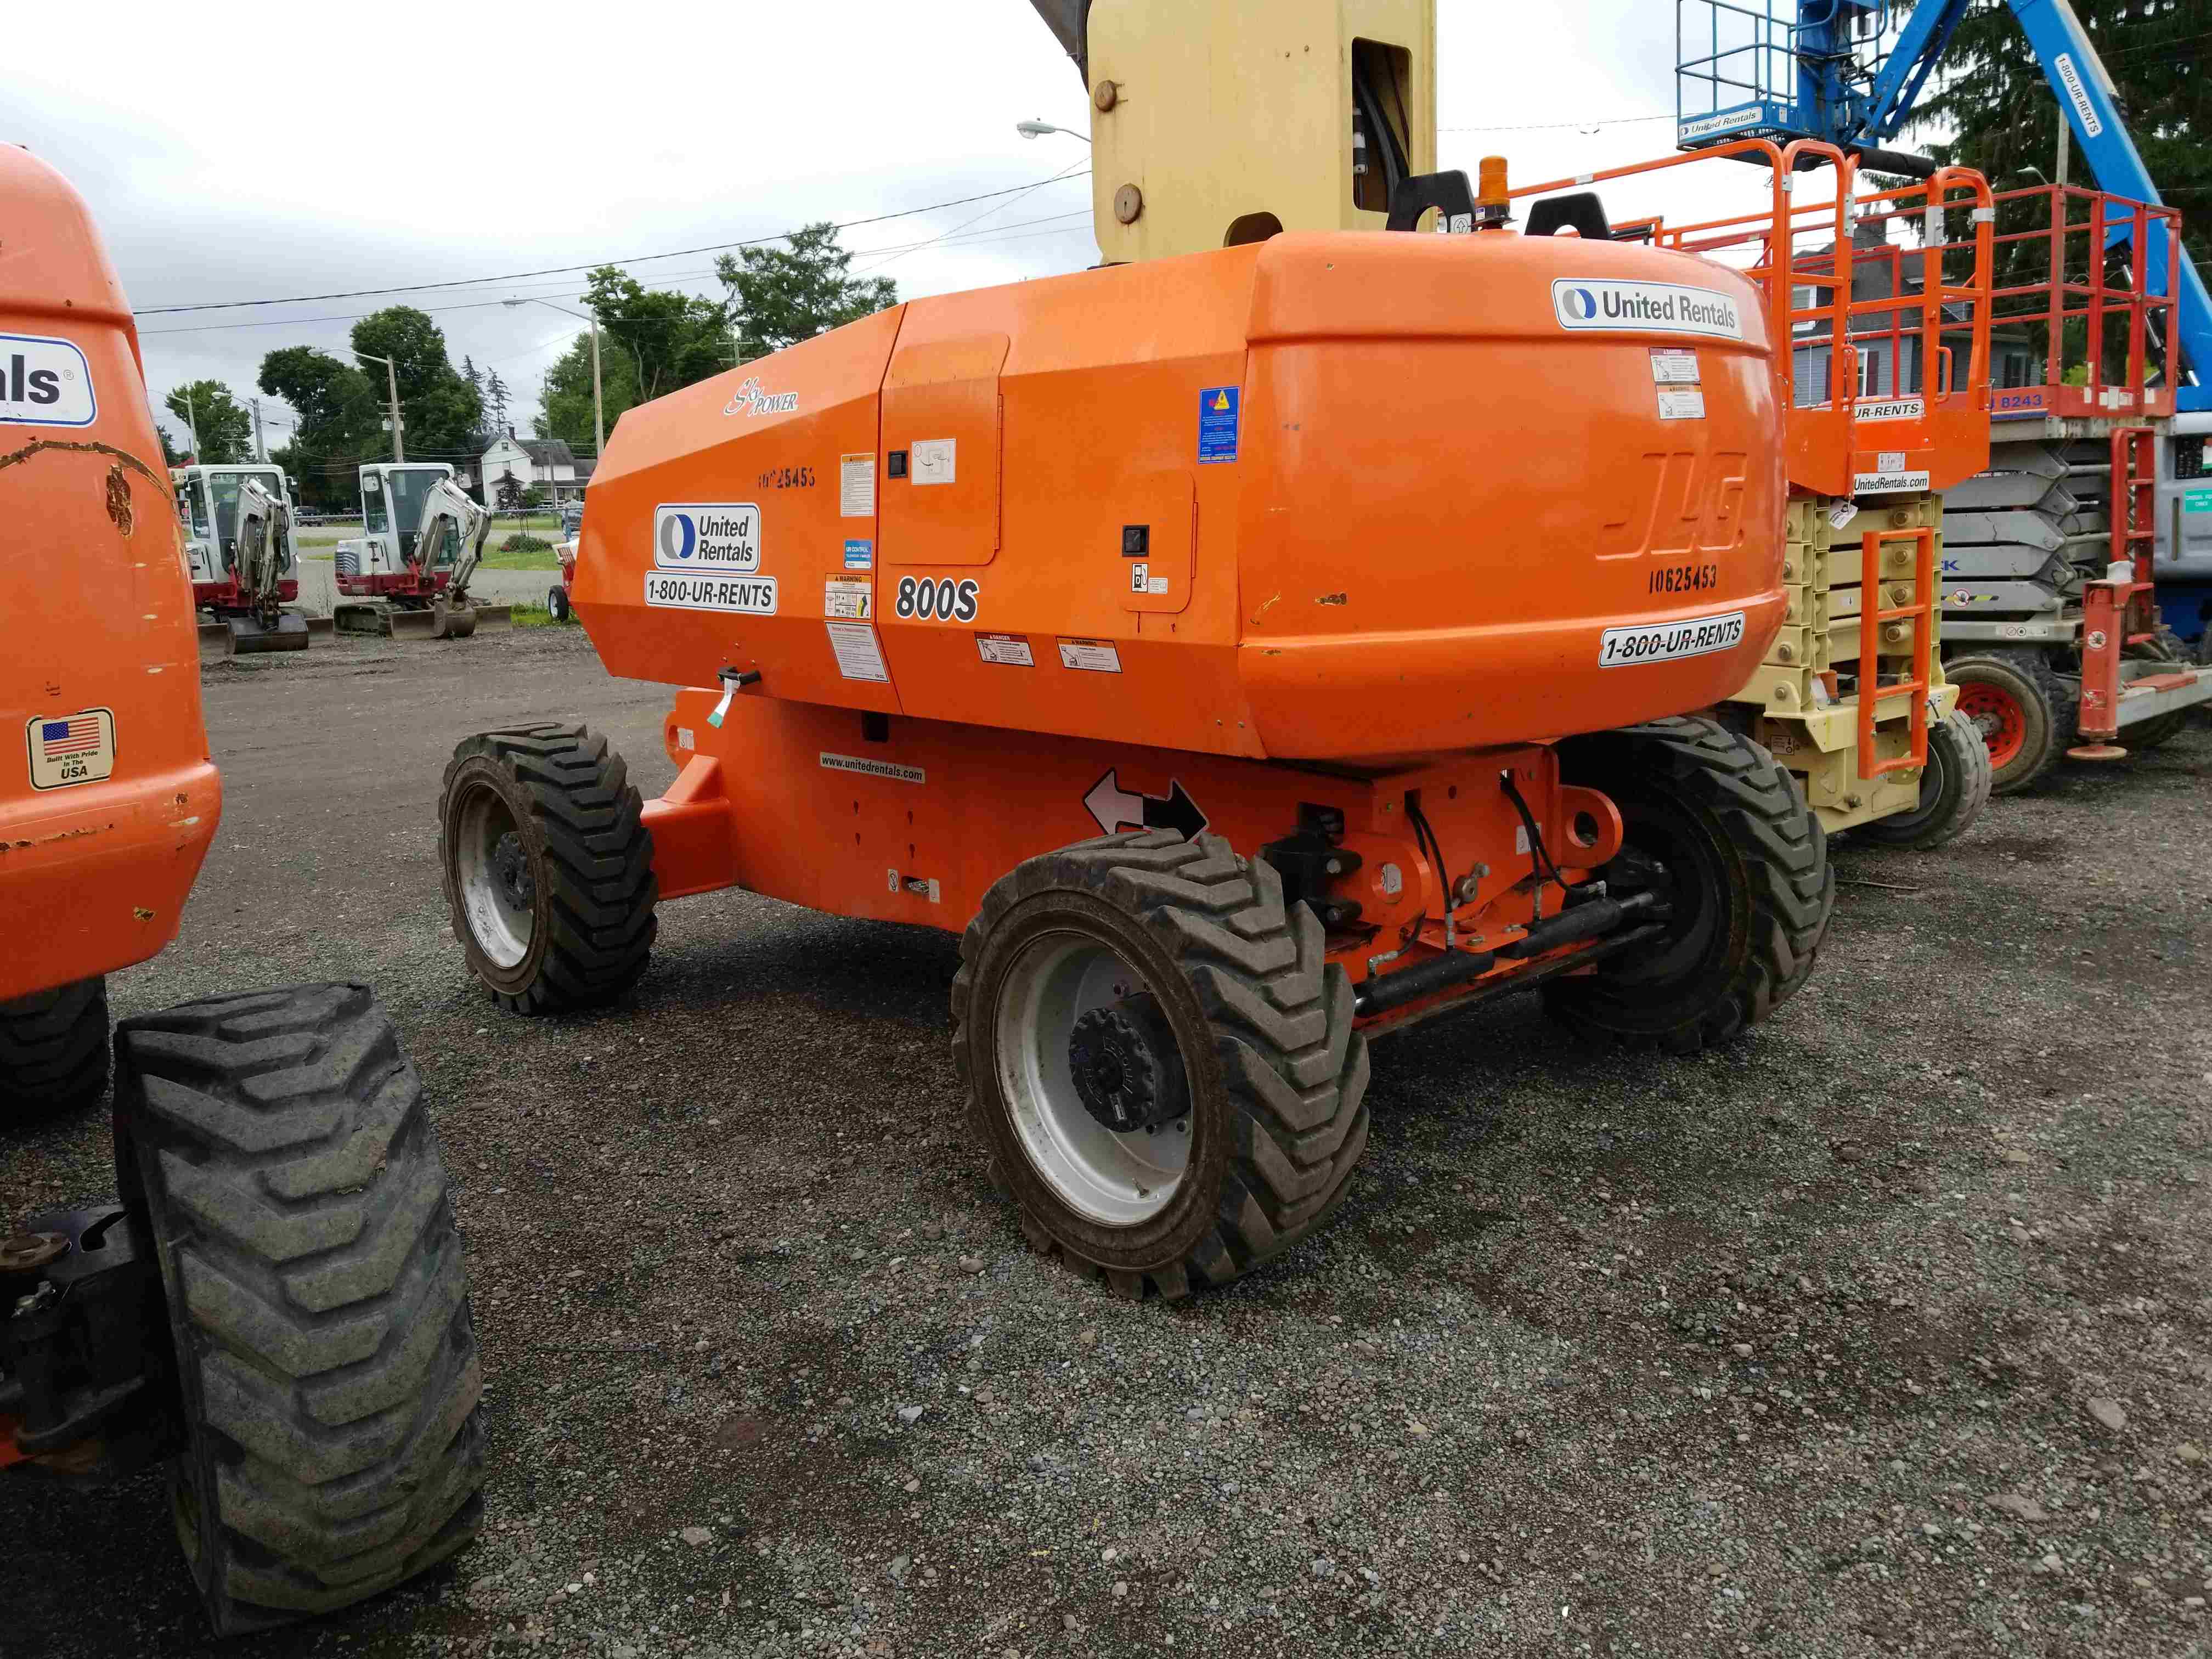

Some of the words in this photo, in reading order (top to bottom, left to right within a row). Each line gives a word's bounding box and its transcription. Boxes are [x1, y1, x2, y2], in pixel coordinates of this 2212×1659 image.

[2058, 57, 2098, 132] 1-800-UR-RENTS
[1691, 120, 1721, 133] United
[1723, 111, 1756, 126] Rentals
[1602, 291, 1675, 320] United
[1679, 295, 1736, 329] Rentals
[0, 354, 60, 404] ls
[755, 392, 799, 413] POWER
[2001, 395, 2042, 408] 8243
[1854, 476, 1927, 491] UnitedRentals.com
[699, 516, 749, 537] United
[698, 539, 753, 562] Rentals
[1941, 560, 1961, 571] K
[1649, 564, 1717, 594] 10625453
[649, 579, 772, 607] 1-800-UR-RENTS
[895, 575, 980, 623] 800S
[1606, 619, 1743, 659] 1-800-UR-RENTS
[47, 755, 63, 763] Built
[822, 756, 922, 780] www.unitedrentals.com
[61, 765, 88, 779] USA
